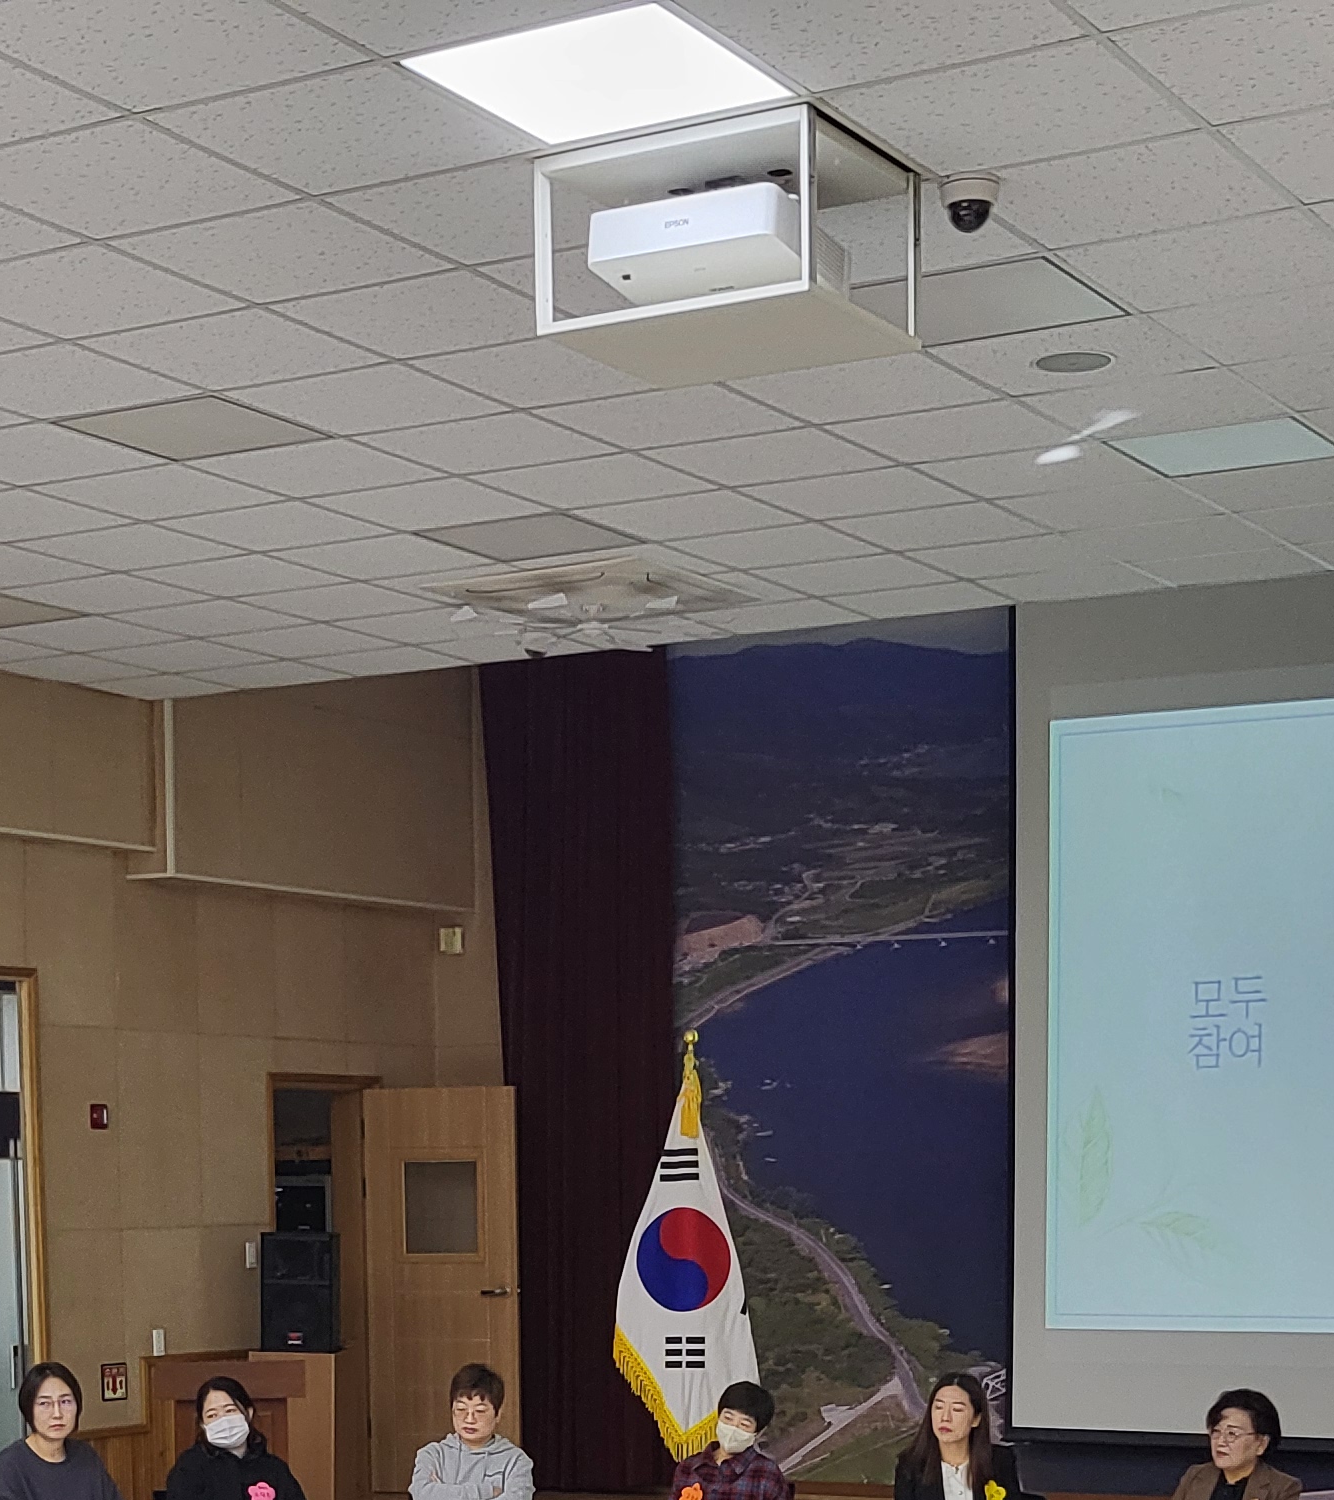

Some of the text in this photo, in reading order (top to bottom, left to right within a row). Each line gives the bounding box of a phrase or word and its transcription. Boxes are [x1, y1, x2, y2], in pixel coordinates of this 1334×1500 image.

[664, 218, 689, 229] EPSON
[1189, 975, 1269, 1020] 모두
[1187, 1022, 1263, 1071] 참여
